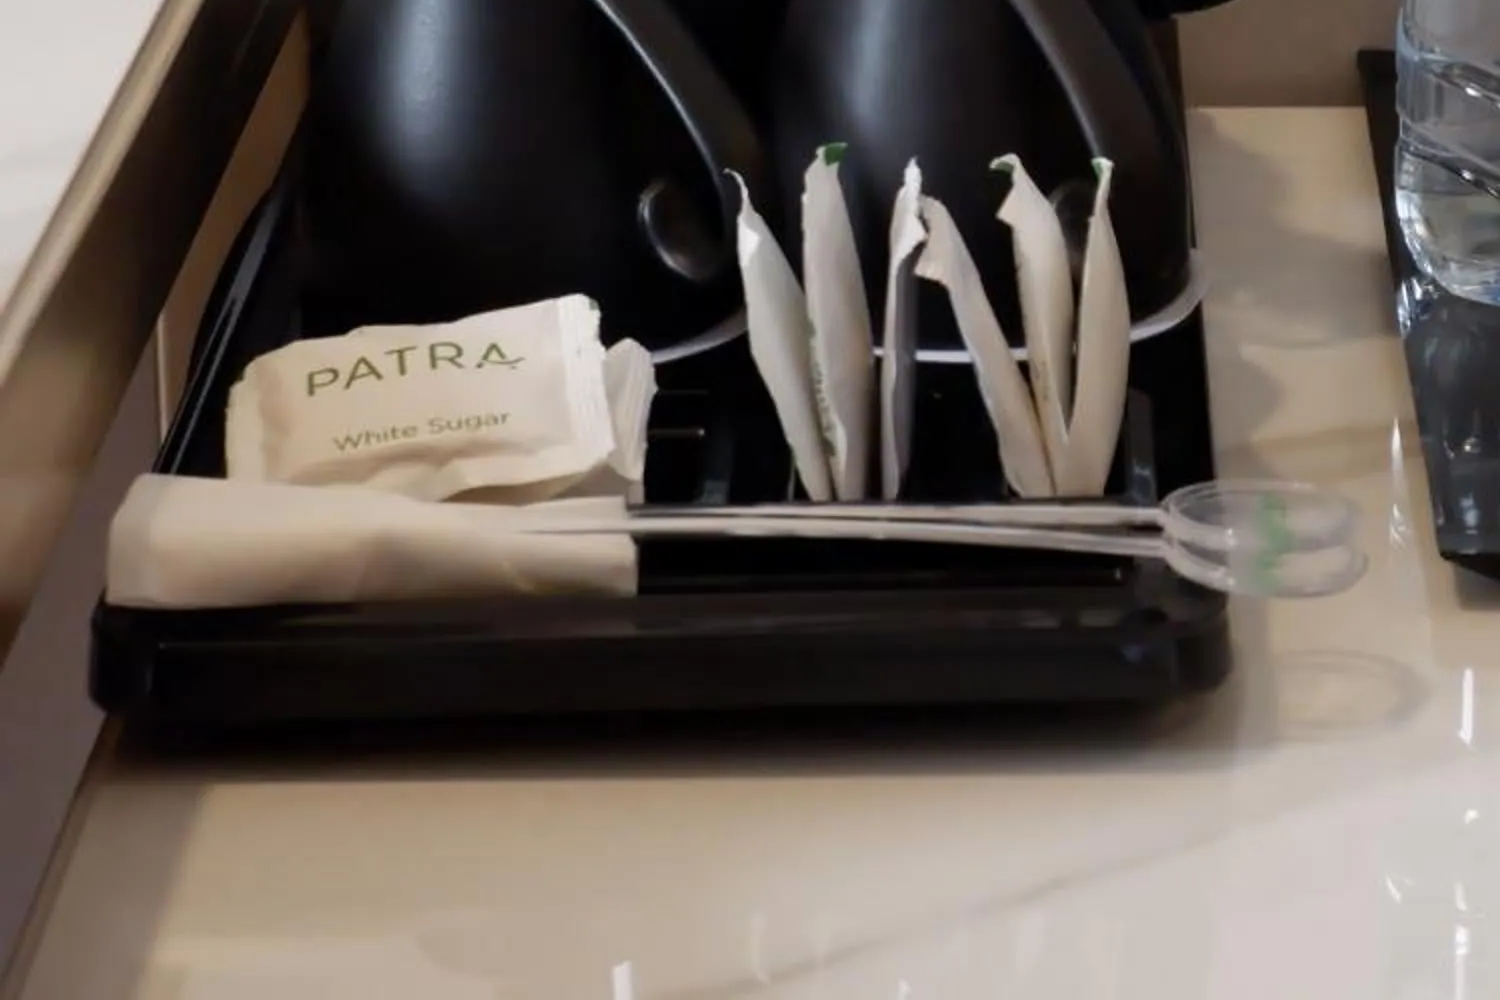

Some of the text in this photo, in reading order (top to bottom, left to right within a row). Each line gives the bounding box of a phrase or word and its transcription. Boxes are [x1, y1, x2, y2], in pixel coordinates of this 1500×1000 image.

[306, 342, 525, 397] PATRA
[332, 412, 511, 452] White Sugar
